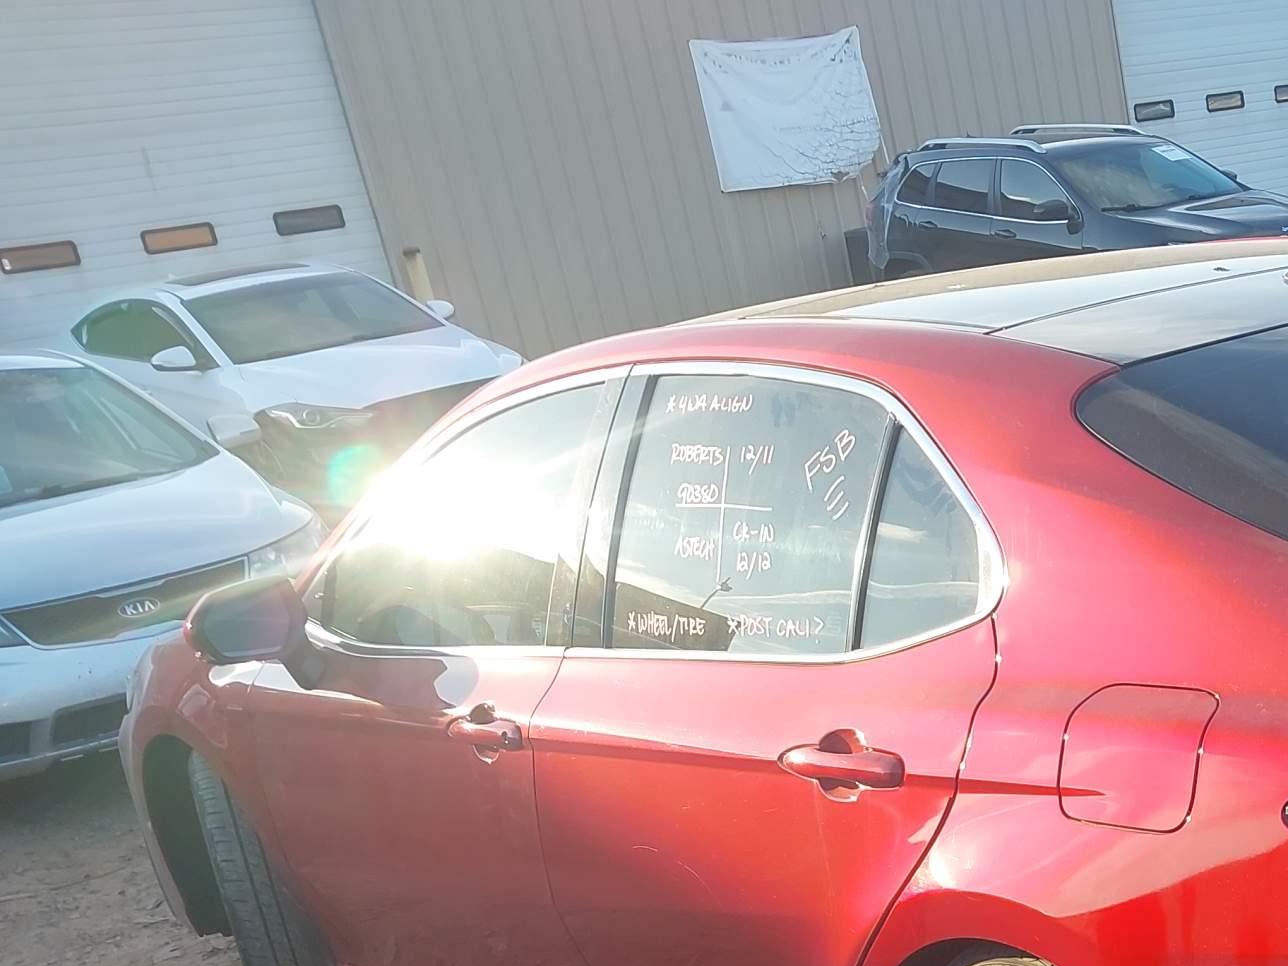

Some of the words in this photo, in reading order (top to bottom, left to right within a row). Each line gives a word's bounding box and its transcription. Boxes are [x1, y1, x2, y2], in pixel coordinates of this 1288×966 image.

[709, 394, 753, 413] ALIGN
[671, 443, 724, 466] ROBERTS
[741, 445, 774, 475] 12/11
[804, 429, 856, 493] FSB
[736, 551, 771, 580] 12/12
[124, 600, 156, 616] KIA
